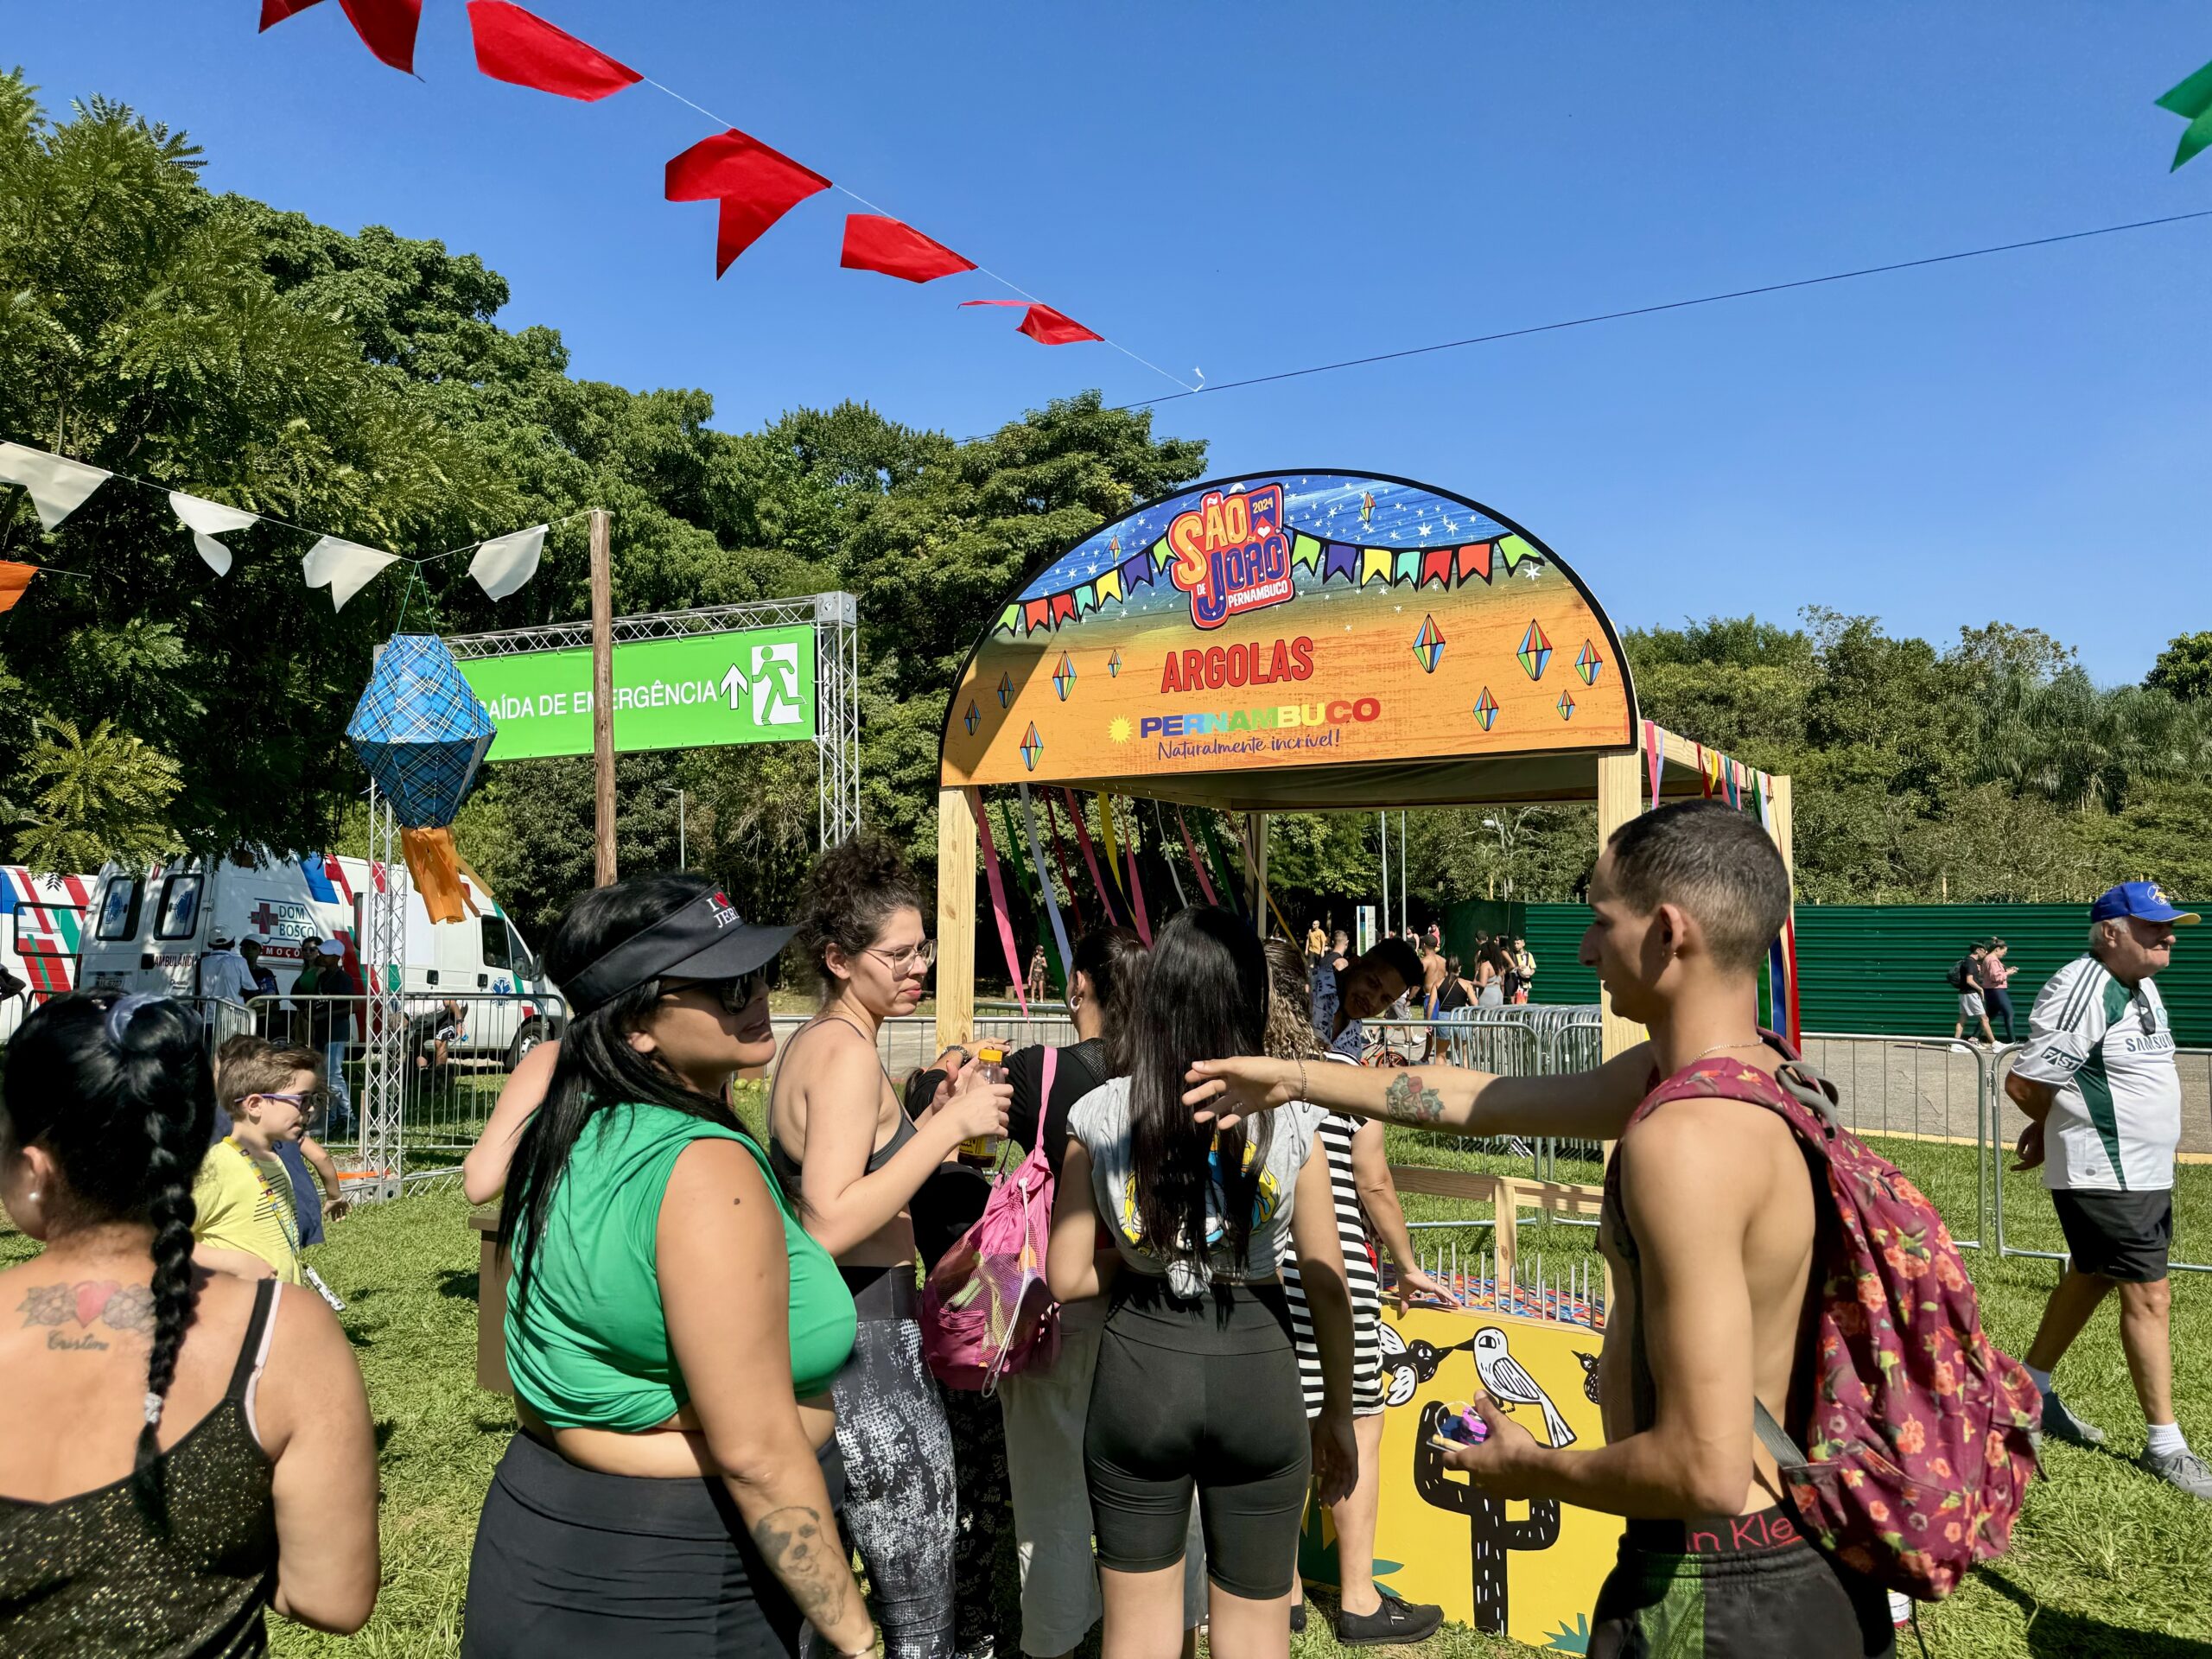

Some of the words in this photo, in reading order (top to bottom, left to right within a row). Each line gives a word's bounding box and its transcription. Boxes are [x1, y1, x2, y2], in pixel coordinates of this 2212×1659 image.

[1252, 497, 1274, 514] 2024
[1173, 497, 1248, 585] SÃO
[1197, 583, 1206, 595] DE
[1198, 536, 1285, 621] JOÃO
[1228, 581, 1288, 608] PERNAMBUCO
[1161, 636, 1314, 693] ARGOLAS
[539, 694, 567, 716] DE
[1141, 698, 1381, 738] PERNAMBUCO
[1159, 736, 1266, 760] Naturalmente
[1271, 729, 1340, 751] incrível!
[279, 906, 305, 919] DOM
[706, 898, 719, 912] I
[279, 924, 315, 938] BOSCO
[2126, 1033, 2174, 1052] SAMSUN
[2042, 1048, 2082, 1070] FAST
[1730, 1513, 1795, 1550] Kle
